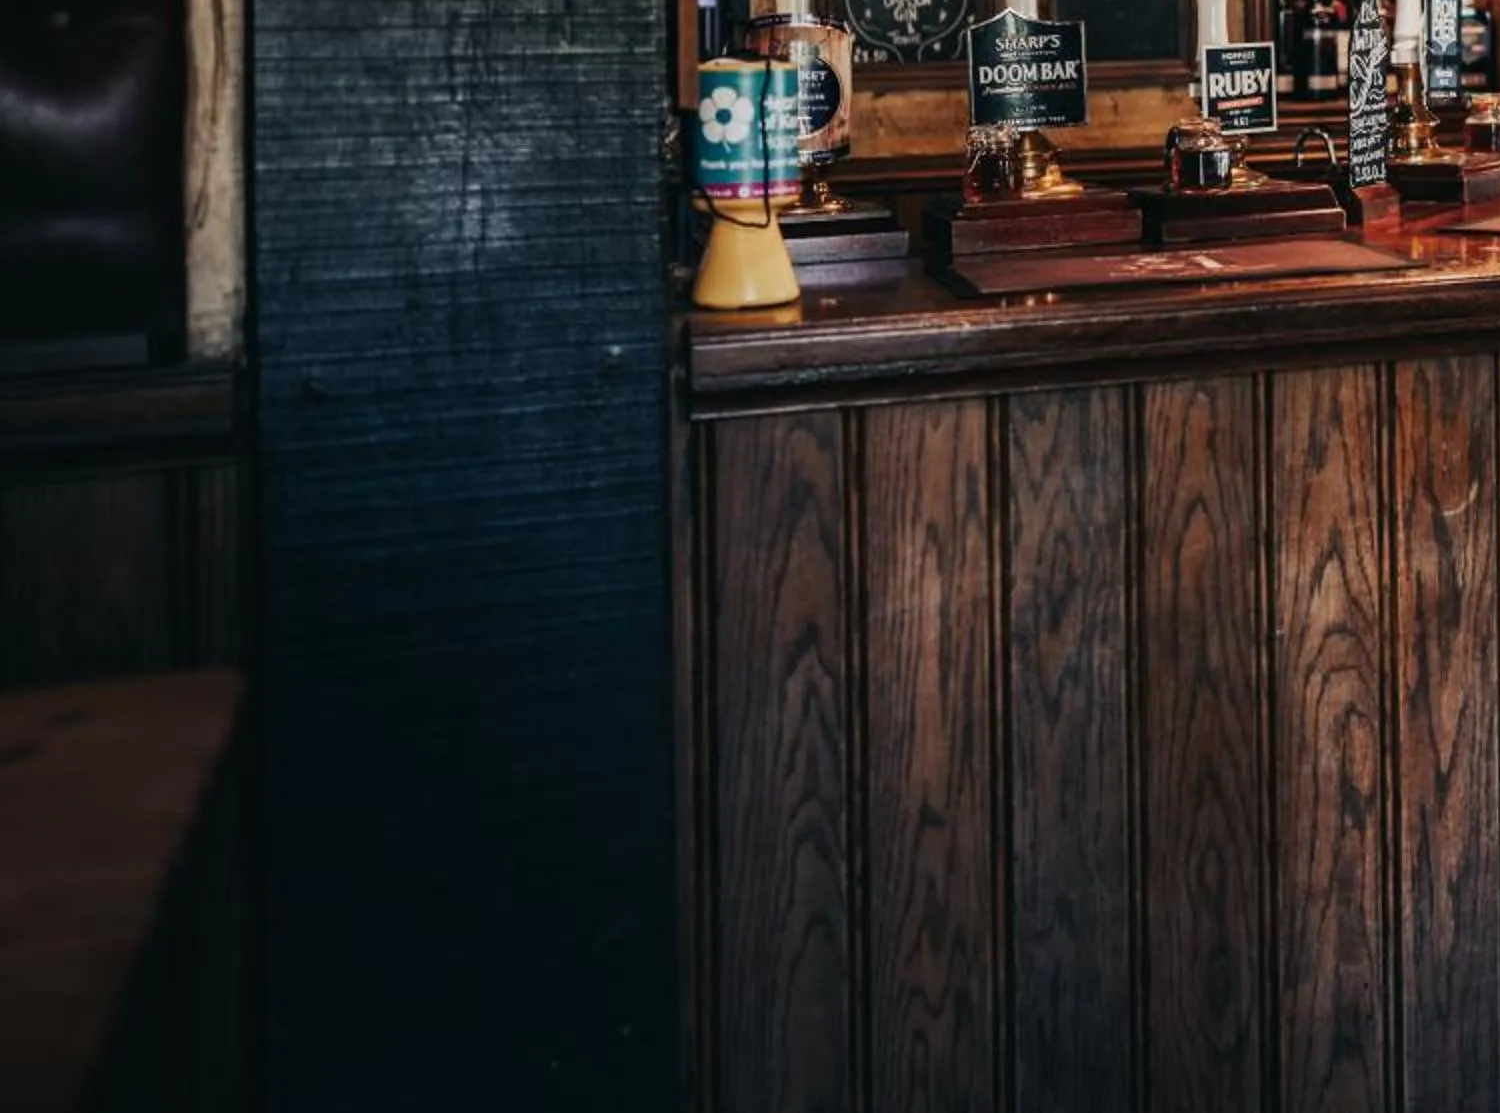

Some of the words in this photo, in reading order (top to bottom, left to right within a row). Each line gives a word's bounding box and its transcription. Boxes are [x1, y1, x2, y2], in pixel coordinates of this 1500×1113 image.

[994, 34, 1062, 52] SHARP'S
[979, 62, 1039, 85] DOOM
[1041, 60, 1079, 81] BAR
[1208, 67, 1273, 99] RUBY
